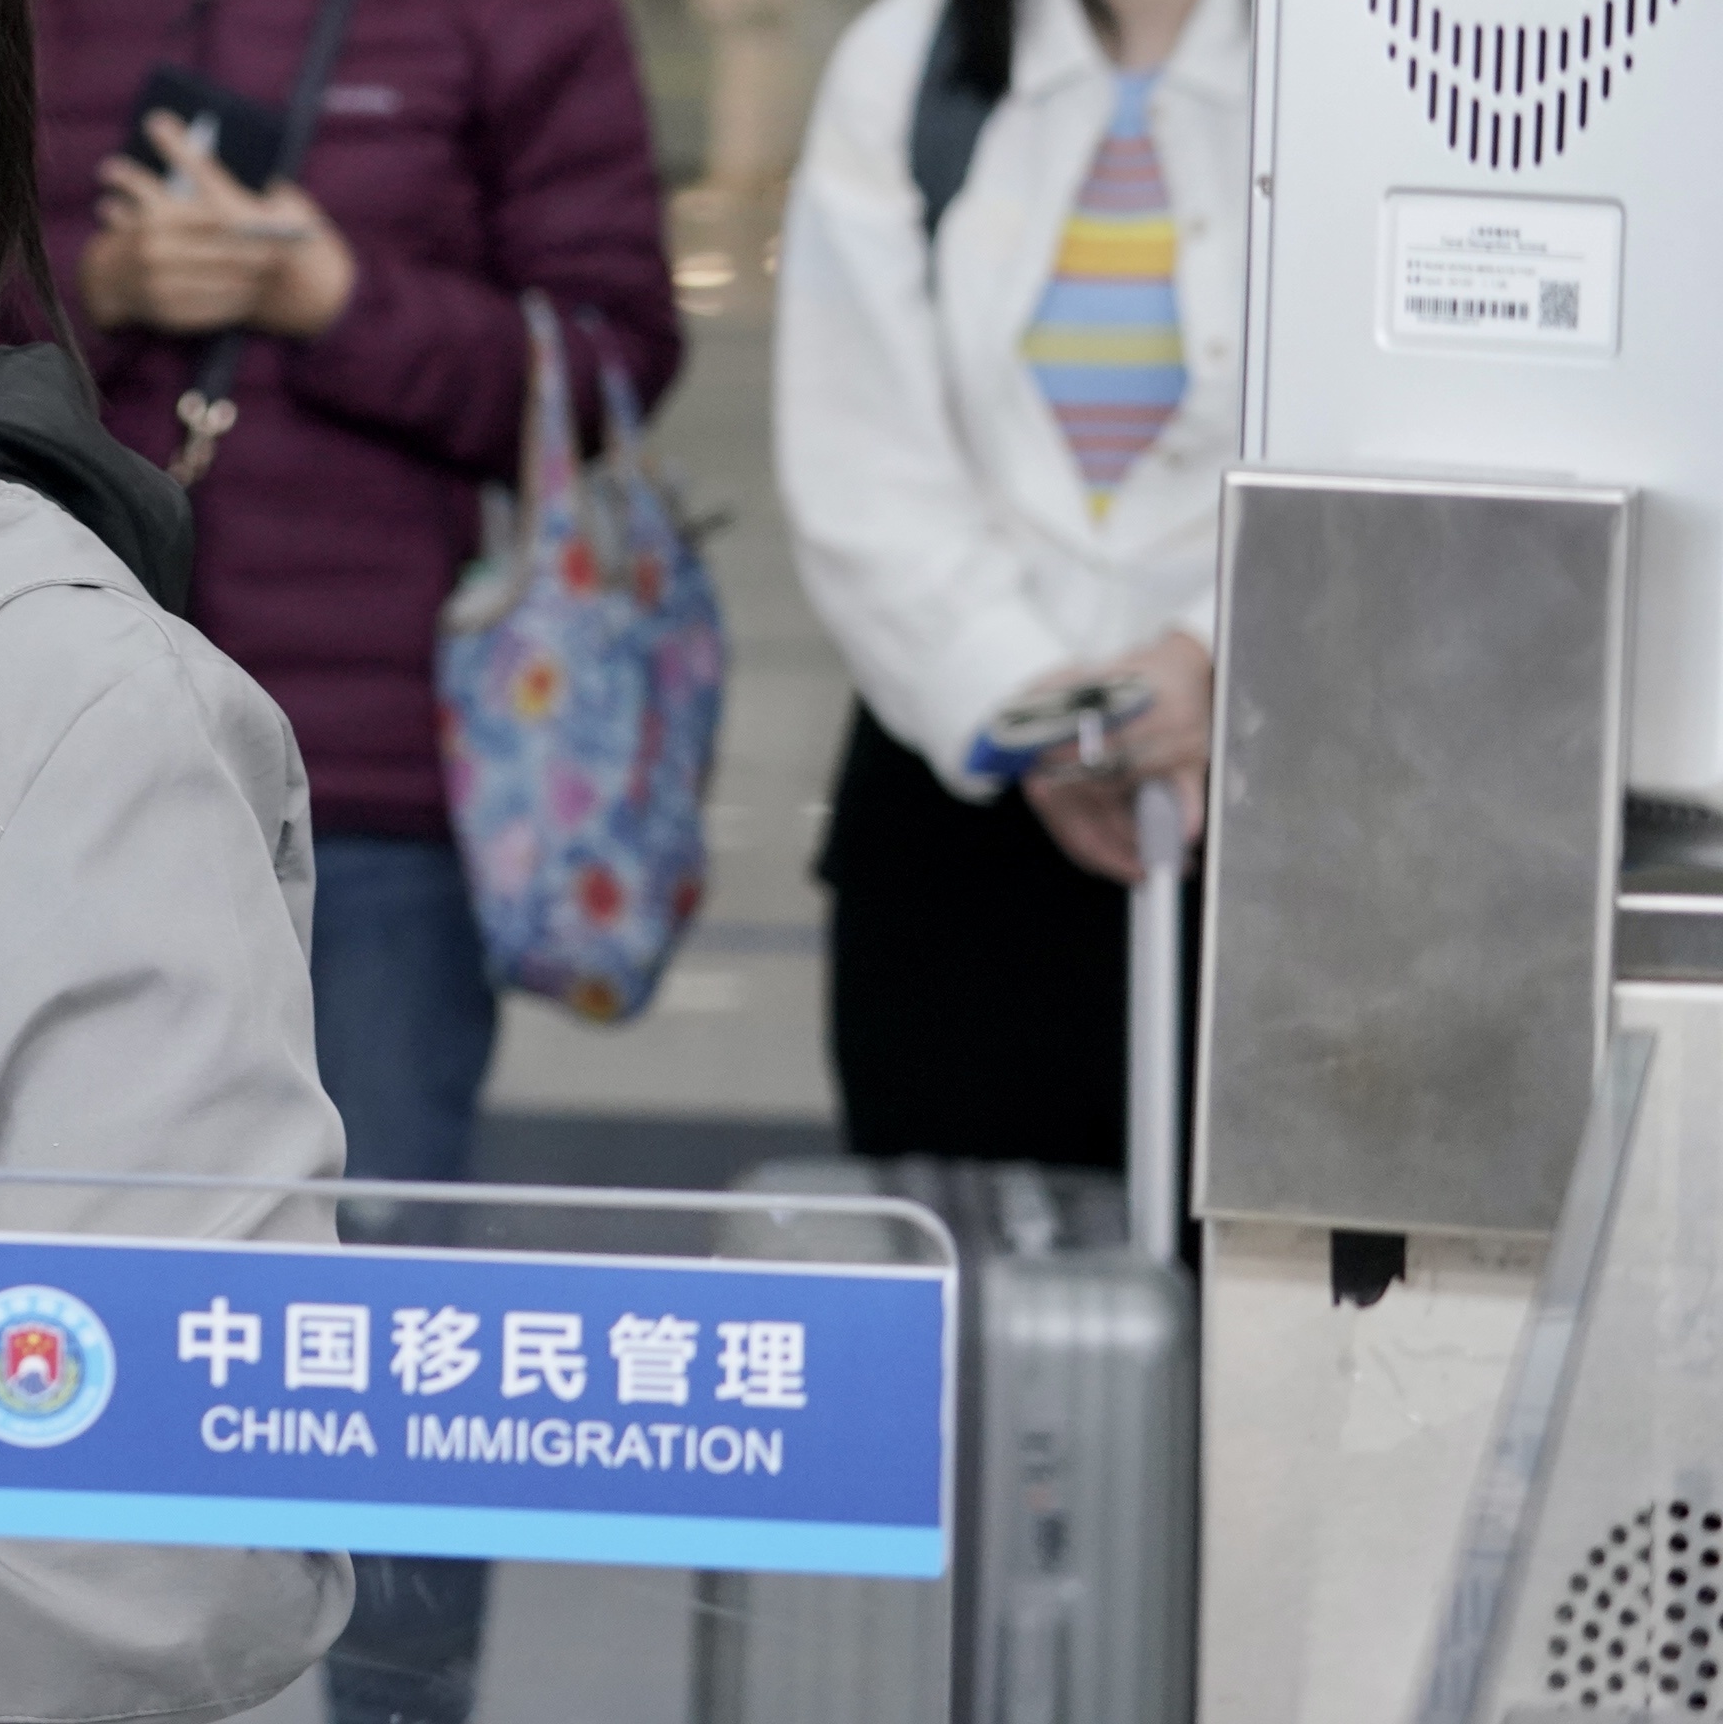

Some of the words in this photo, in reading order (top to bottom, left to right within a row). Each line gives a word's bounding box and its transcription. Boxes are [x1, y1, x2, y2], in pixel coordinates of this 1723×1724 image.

[177, 1296, 808, 1409] 中国移民管理
[200, 1405, 378, 1456] CHINA
[406, 1414, 783, 1475] IMMIGRATION
